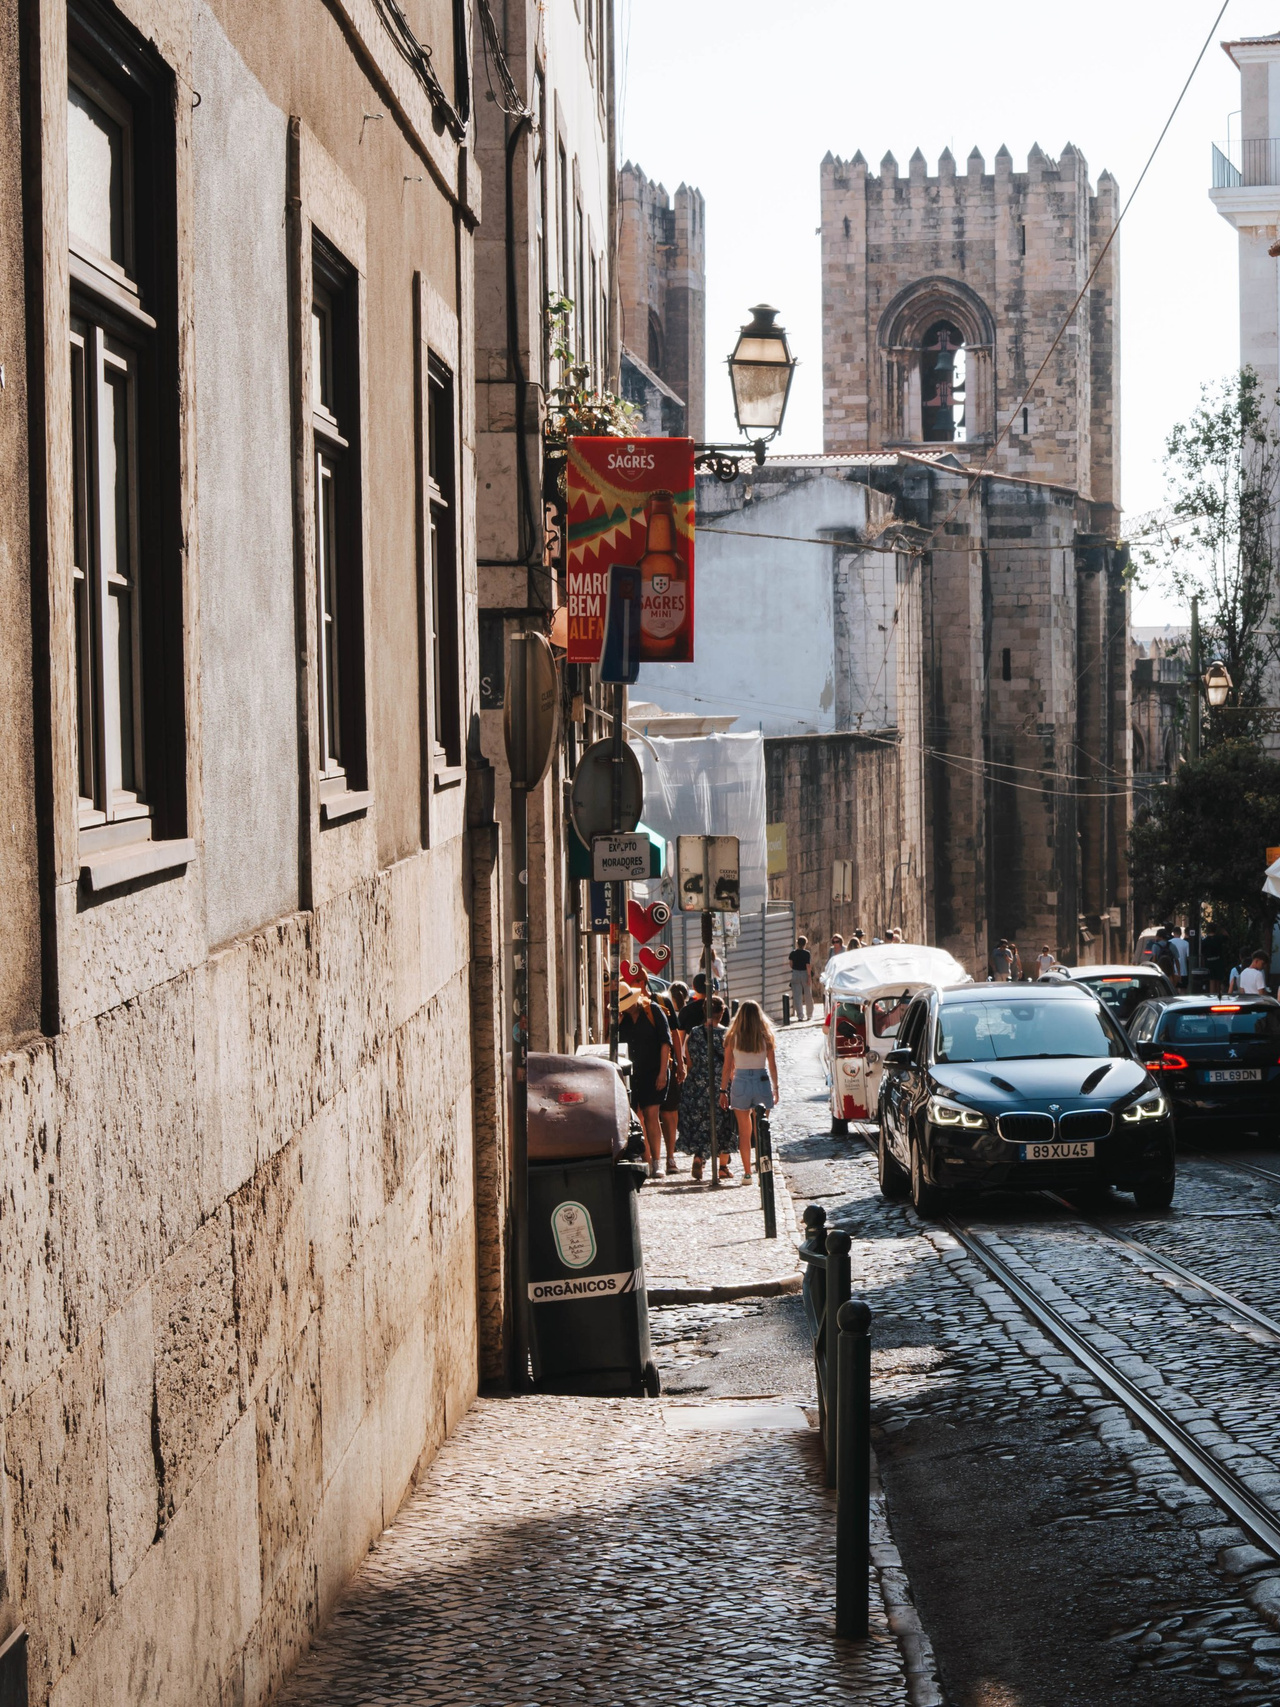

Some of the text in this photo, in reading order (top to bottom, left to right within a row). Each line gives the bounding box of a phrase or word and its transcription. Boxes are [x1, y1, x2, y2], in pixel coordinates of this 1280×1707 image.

[607, 453, 655, 470] SAGRES
[569, 595, 600, 617] BEM
[602, 856, 643, 867] MORADORES
[534, 1278, 616, 1298] ORGÂNICOS
